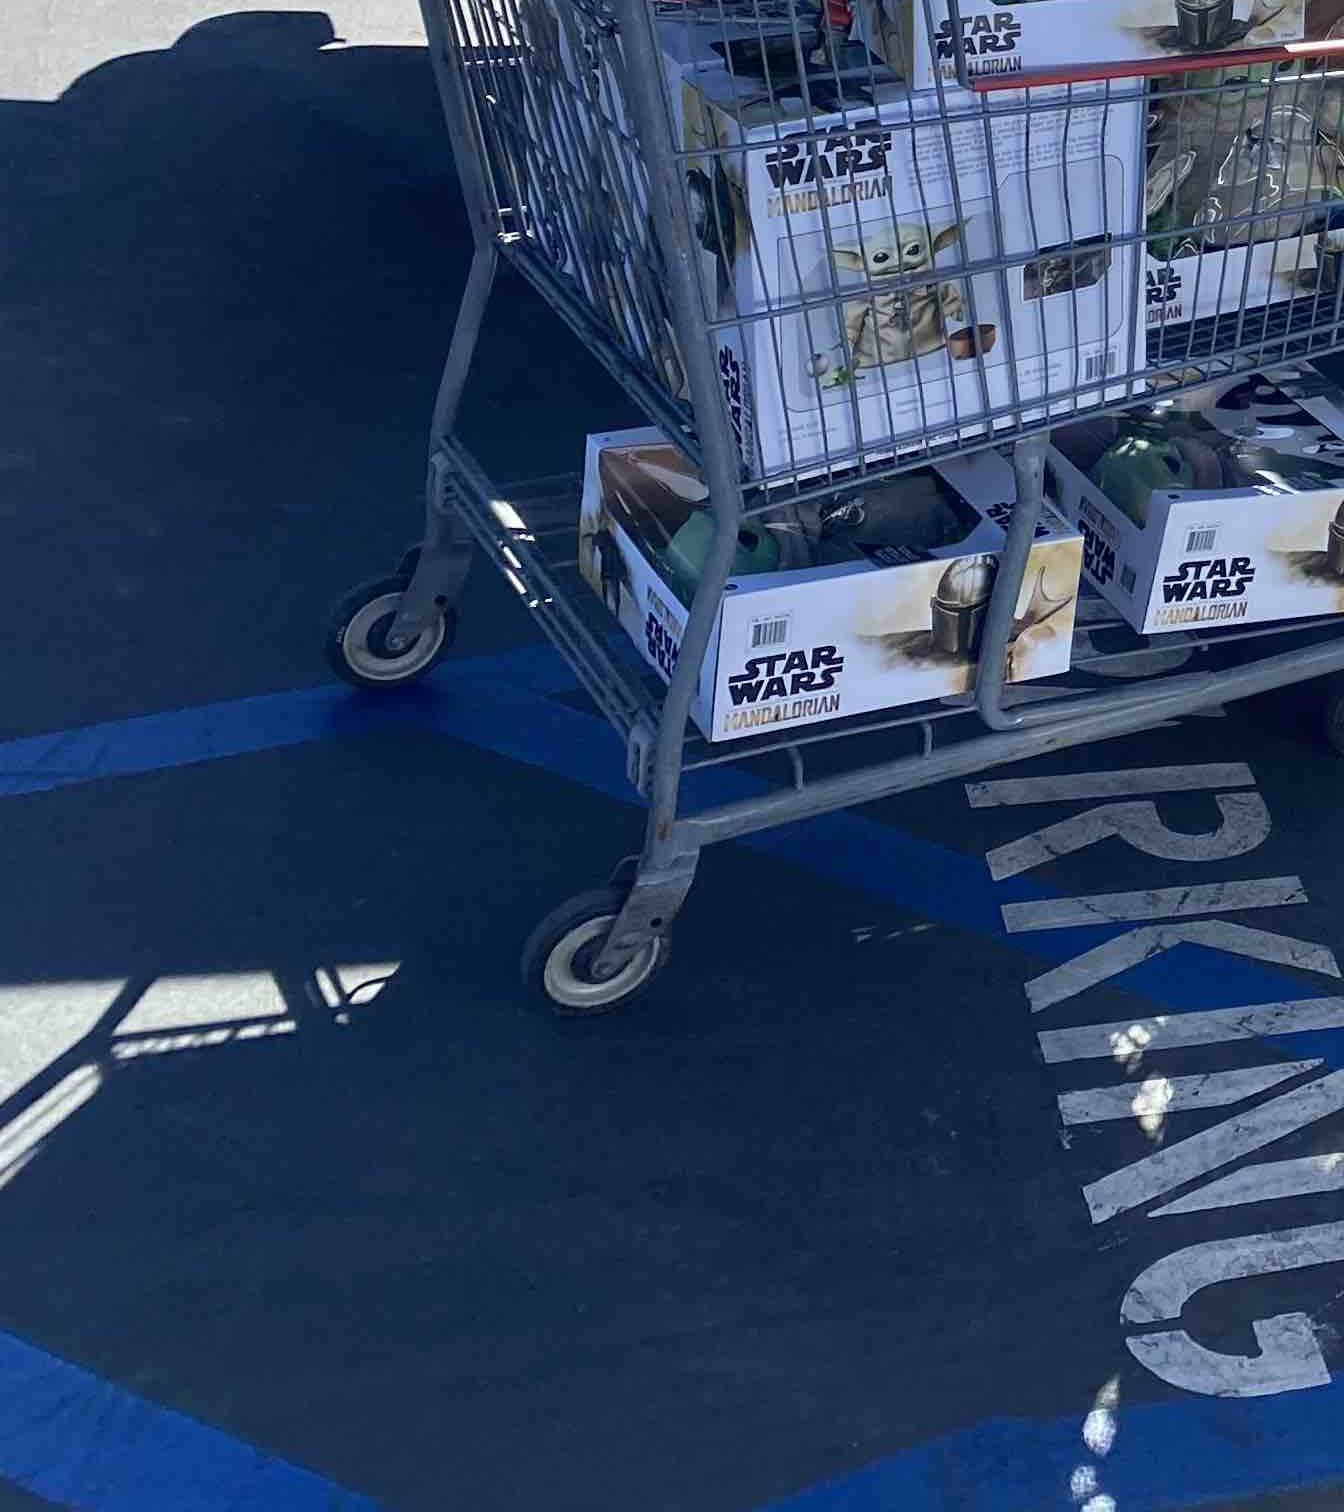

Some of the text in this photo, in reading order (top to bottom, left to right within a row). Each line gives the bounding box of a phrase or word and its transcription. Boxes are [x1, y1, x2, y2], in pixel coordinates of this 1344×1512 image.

[766, 143, 892, 188] WARS
[1164, 557, 1255, 582] STAR
[1163, 576, 1254, 603] WARS
[1153, 601, 1248, 625] MANDALORIAN
[728, 644, 844, 683] STAR
[728, 667, 843, 706] WARS
[724, 693, 841, 732] MANDALORIAN
